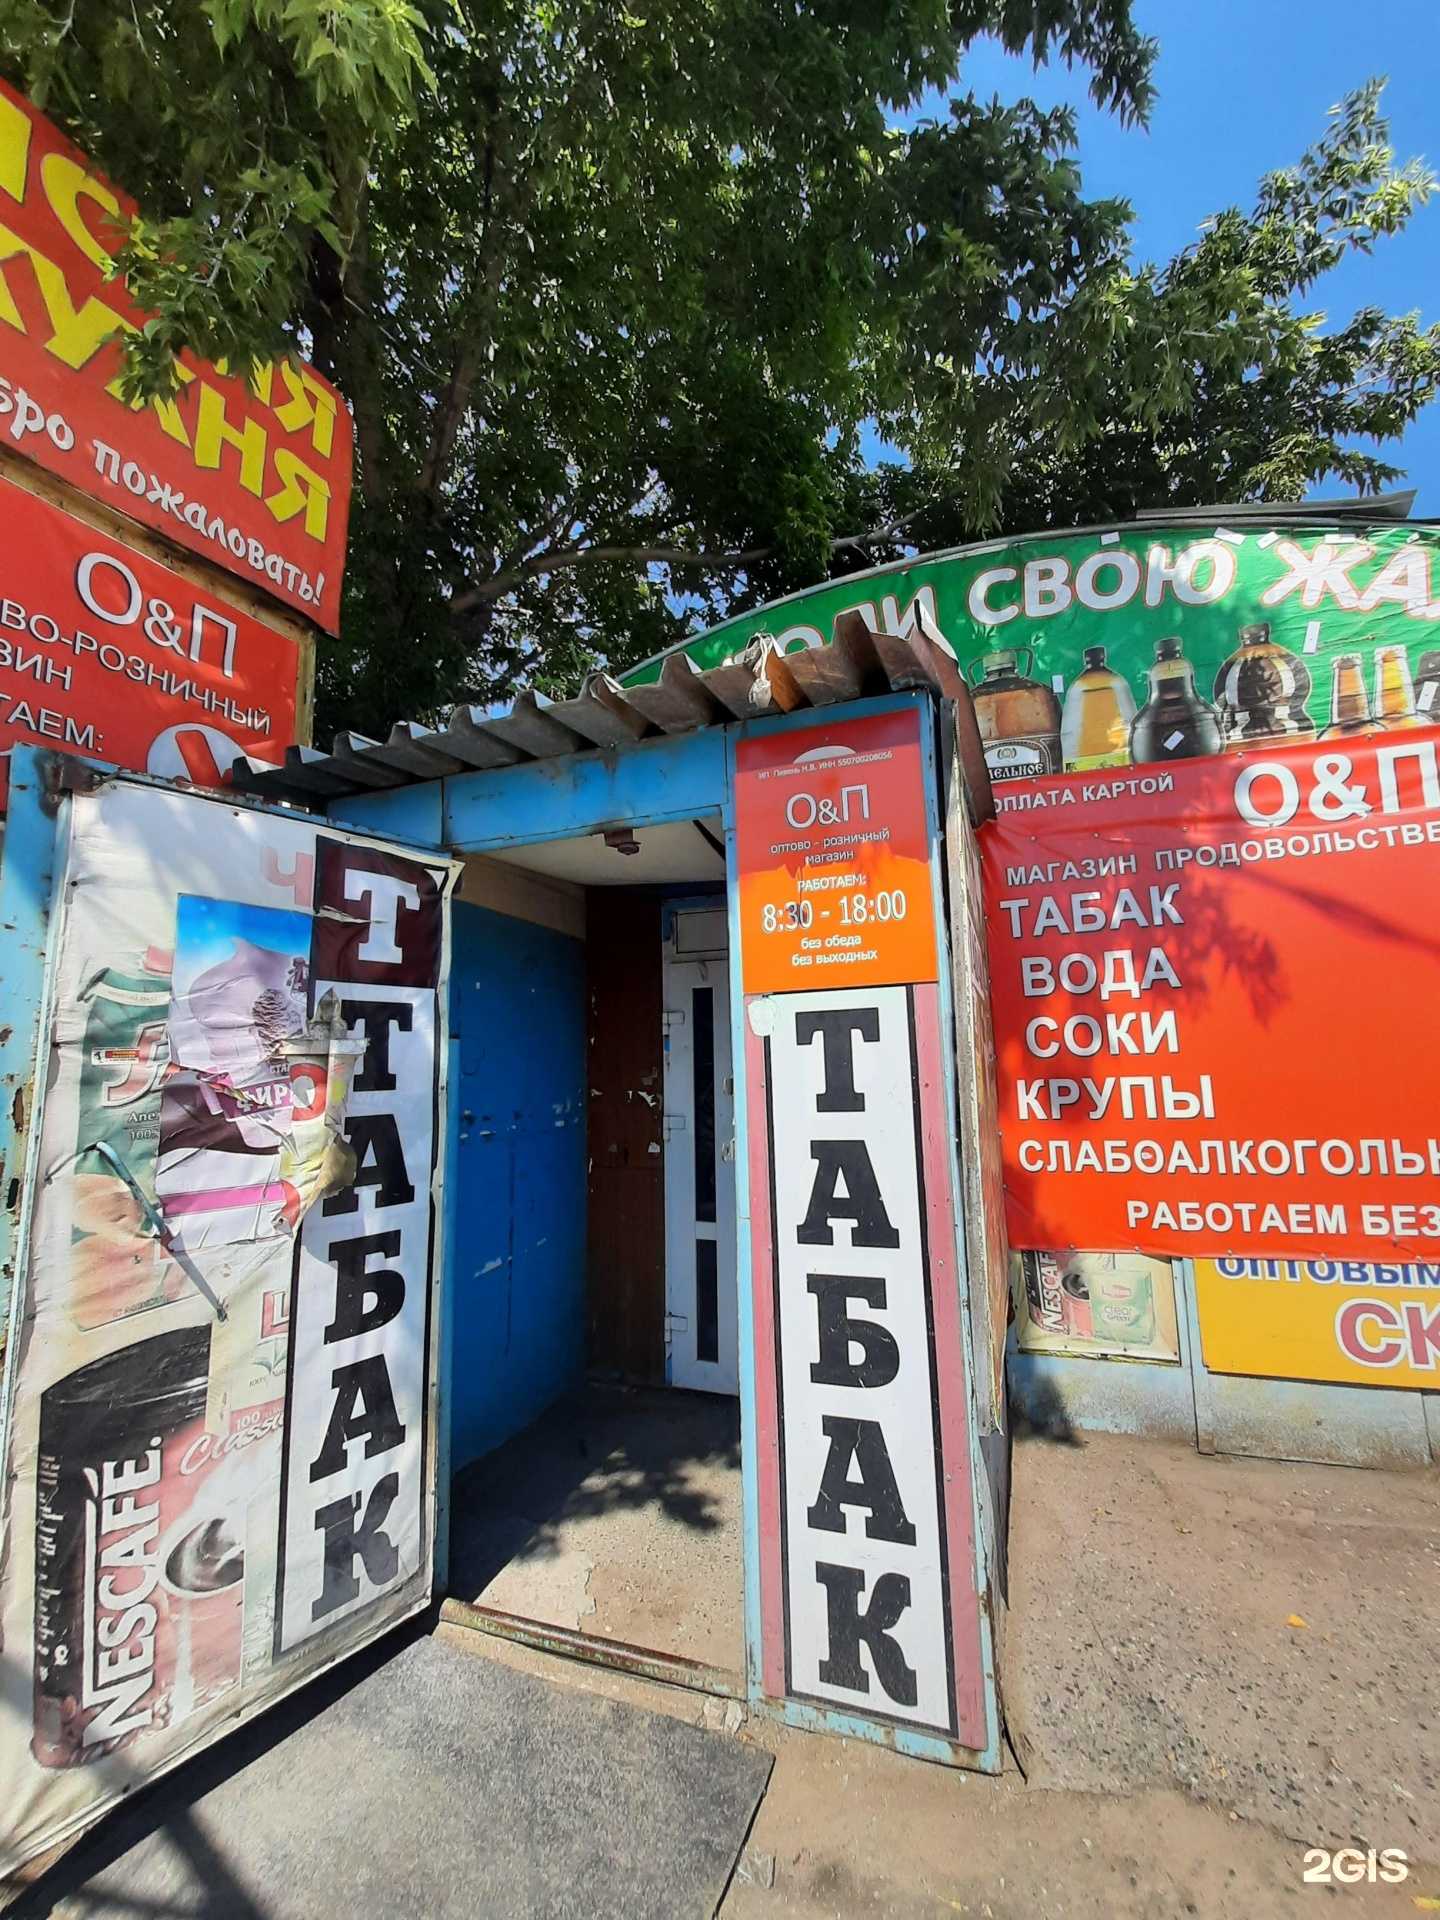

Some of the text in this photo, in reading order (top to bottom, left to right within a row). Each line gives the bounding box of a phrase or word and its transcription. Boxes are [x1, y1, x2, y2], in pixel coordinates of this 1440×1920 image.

[93, 439, 325, 608] пожаловать!
[967, 541, 1236, 626] СВОЮ
[1260, 540, 1440, 619] ЖА
[76, 551, 238, 679] О&П
[0, 691, 104, 753] АЕМ:
[786, 784, 869, 829] О&П
[1082, 772, 1174, 802] КАРТОЙ
[1234, 741, 1440, 828] О&П
[770, 838, 811, 855] оптово
[823, 826, 890, 849] розничный
[805, 850, 854, 865] магазин
[797, 873, 866, 893] РАБОТАЕМ:
[1006, 854, 1137, 886] МАГАЗИН
[763, 900, 813, 934] 8:30
[839, 889, 907, 926] 18:00
[999, 882, 1185, 939] ТАБАК
[792, 948, 877, 967] без выходных
[801, 934, 862, 950] без обеда
[1021, 946, 1183, 1001] ВОДА
[1025, 1009, 1179, 1059] СОКИ
[1016, 1075, 1215, 1121] КРУПЫ
[1127, 1201, 1440, 1238] РАБОТАЕМ БЕЗ
[795, 1006, 918, 1707] ТАБАК
